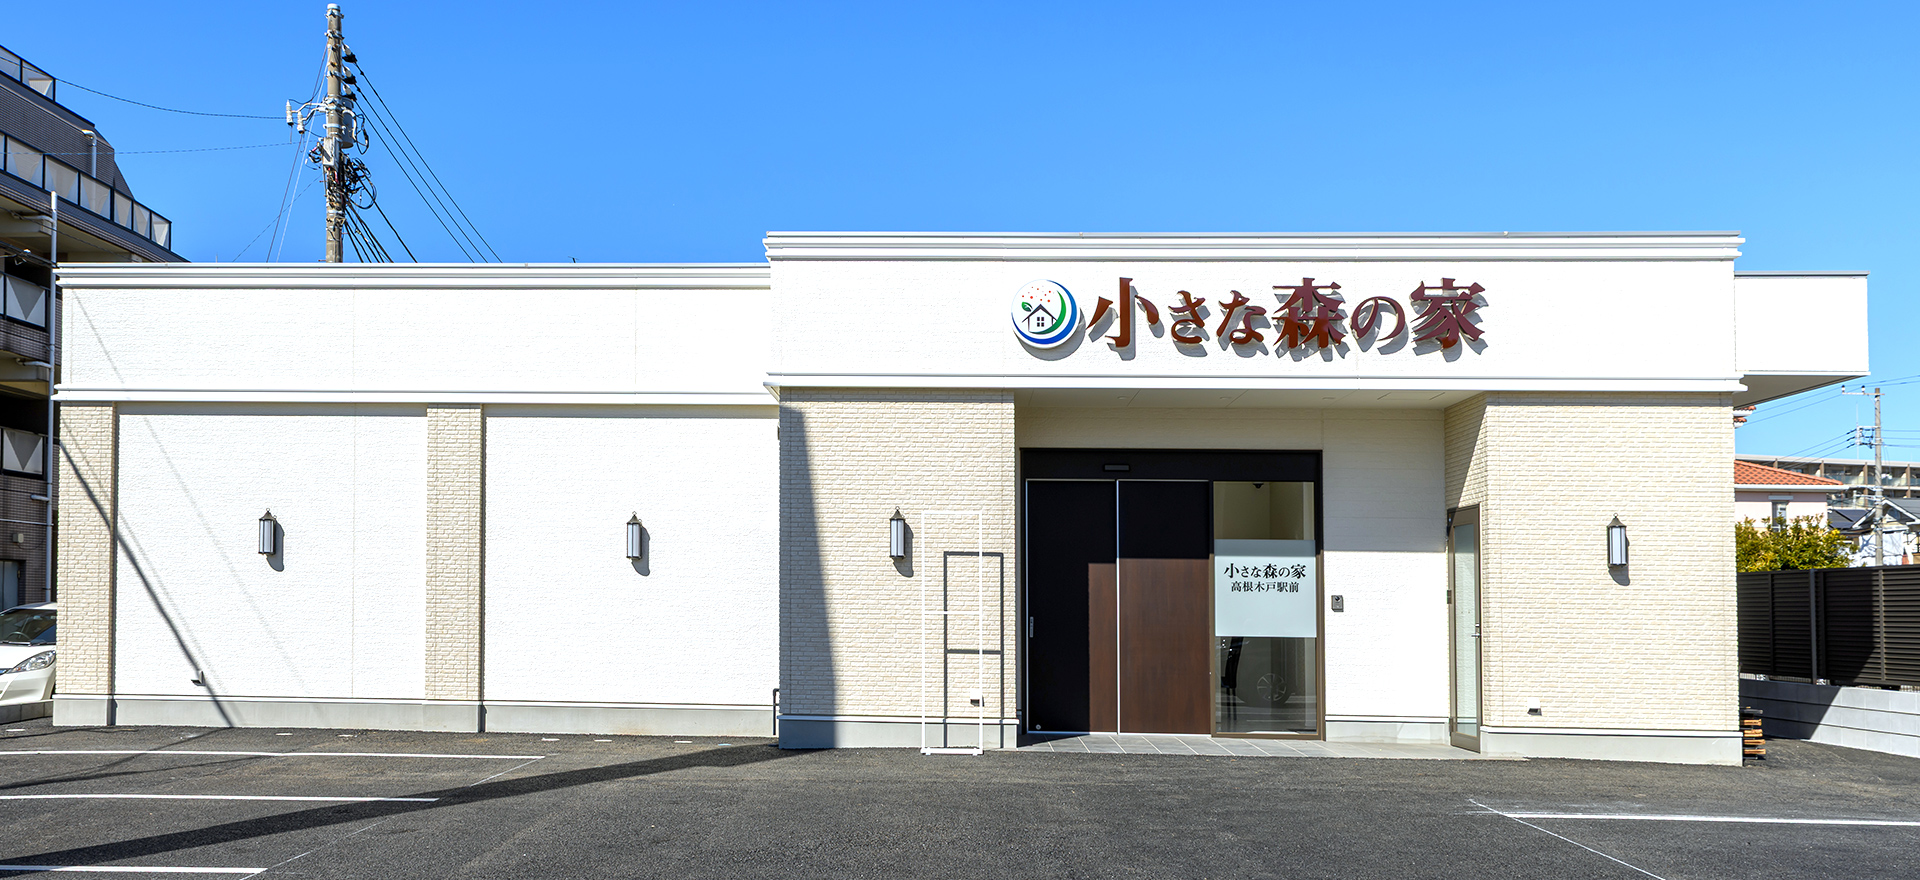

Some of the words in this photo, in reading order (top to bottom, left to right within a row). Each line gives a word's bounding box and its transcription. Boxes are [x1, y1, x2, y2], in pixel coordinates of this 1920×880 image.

[1085, 276, 1486, 351] 小さな森の家
[1223, 563, 1307, 579] 小さな森の家
[1231, 580, 1300, 593] 高根木戸駅前
